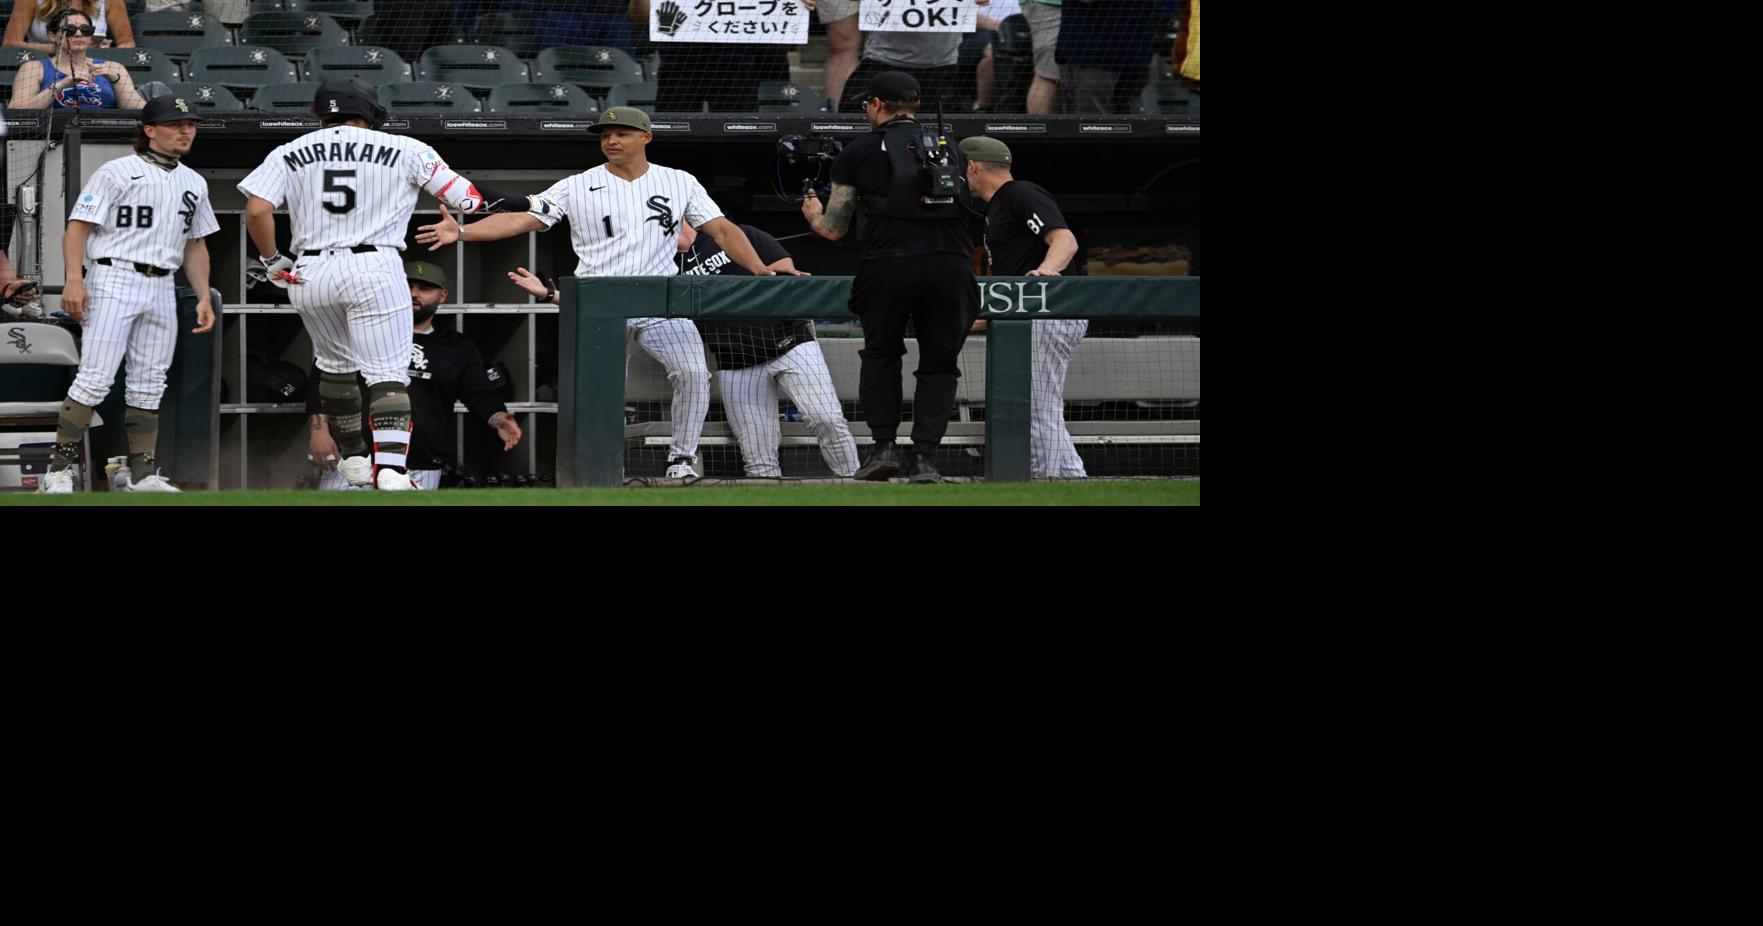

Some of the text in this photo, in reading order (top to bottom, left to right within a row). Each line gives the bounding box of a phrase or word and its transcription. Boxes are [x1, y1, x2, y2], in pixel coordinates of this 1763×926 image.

[901, 7, 959, 28] OK!
[329, 99, 337, 107] 5
[283, 142, 402, 172] MURAKAMI
[322, 170, 356, 214] 5
[74, 202, 96, 213] CME
[644, 195, 679, 237] Sox
[602, 215, 614, 238] 1
[704, 250, 731, 272] SOX
